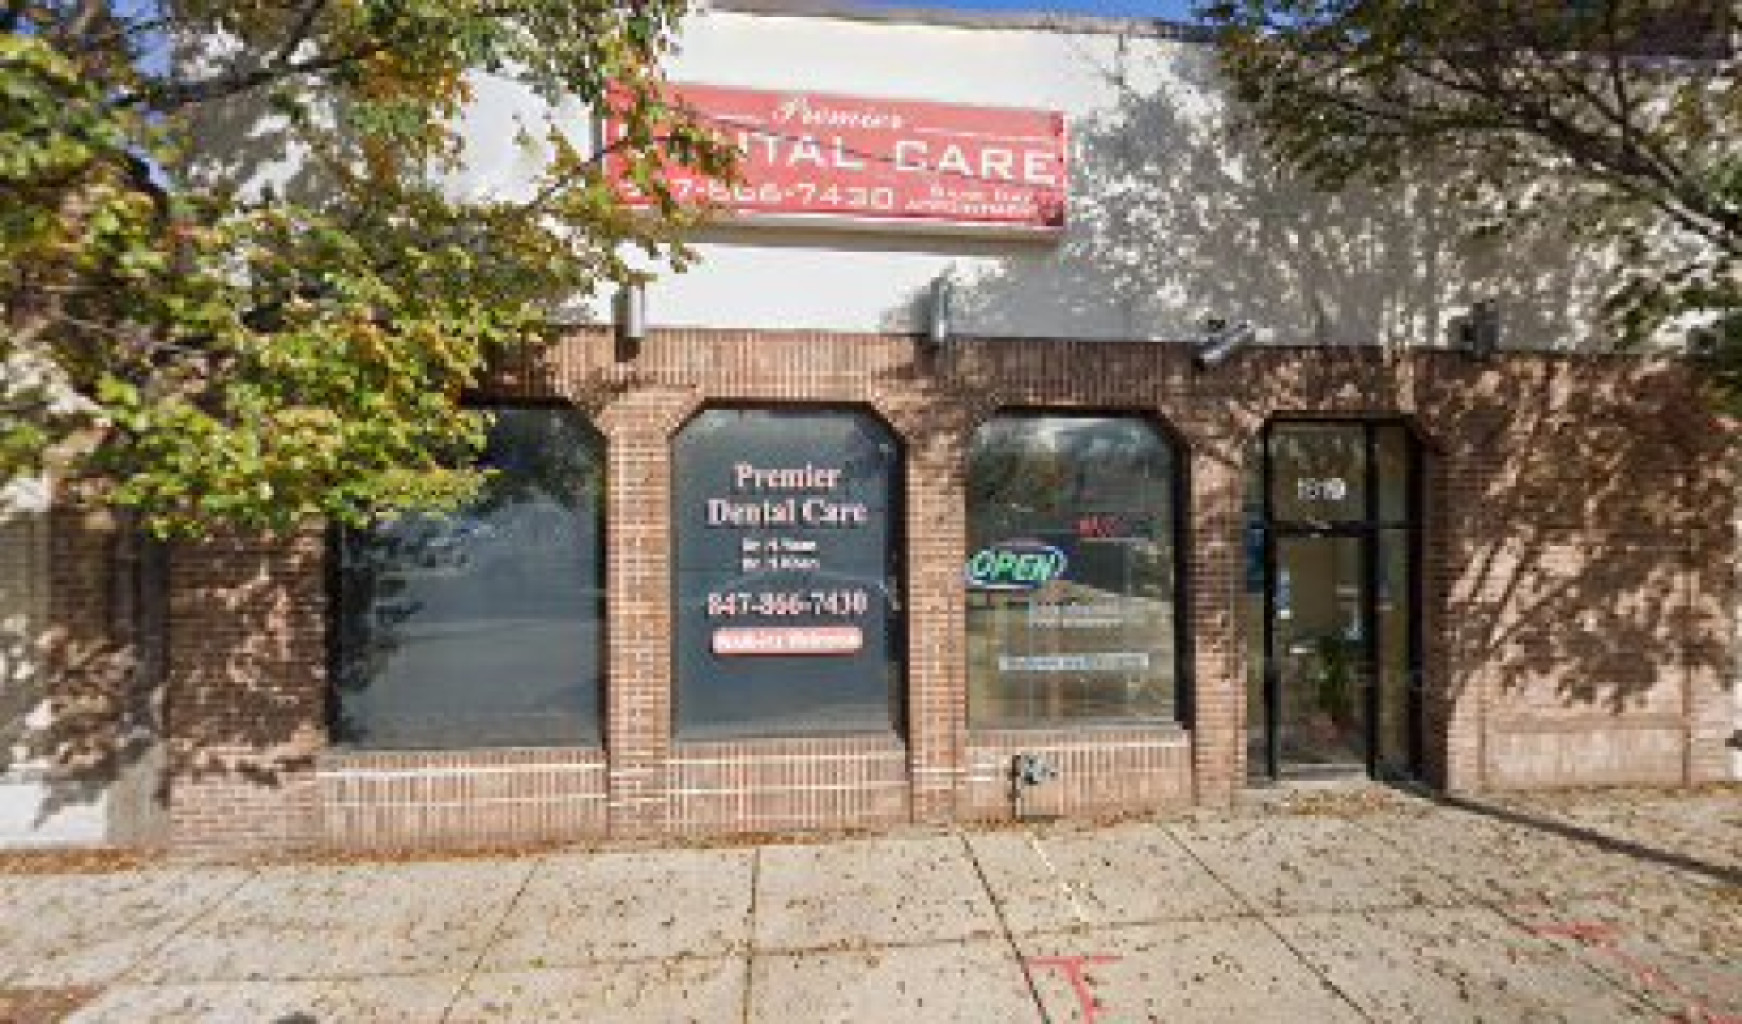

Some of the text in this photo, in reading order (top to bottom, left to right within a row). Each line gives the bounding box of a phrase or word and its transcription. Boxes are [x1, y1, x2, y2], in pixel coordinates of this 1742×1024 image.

[895, 139, 1057, 186] CARE
[734, 461, 842, 487] Premier
[707, 499, 868, 525] Dental Care
[972, 548, 1057, 582] OPEN
[707, 589, 869, 616] 847-866-7430
